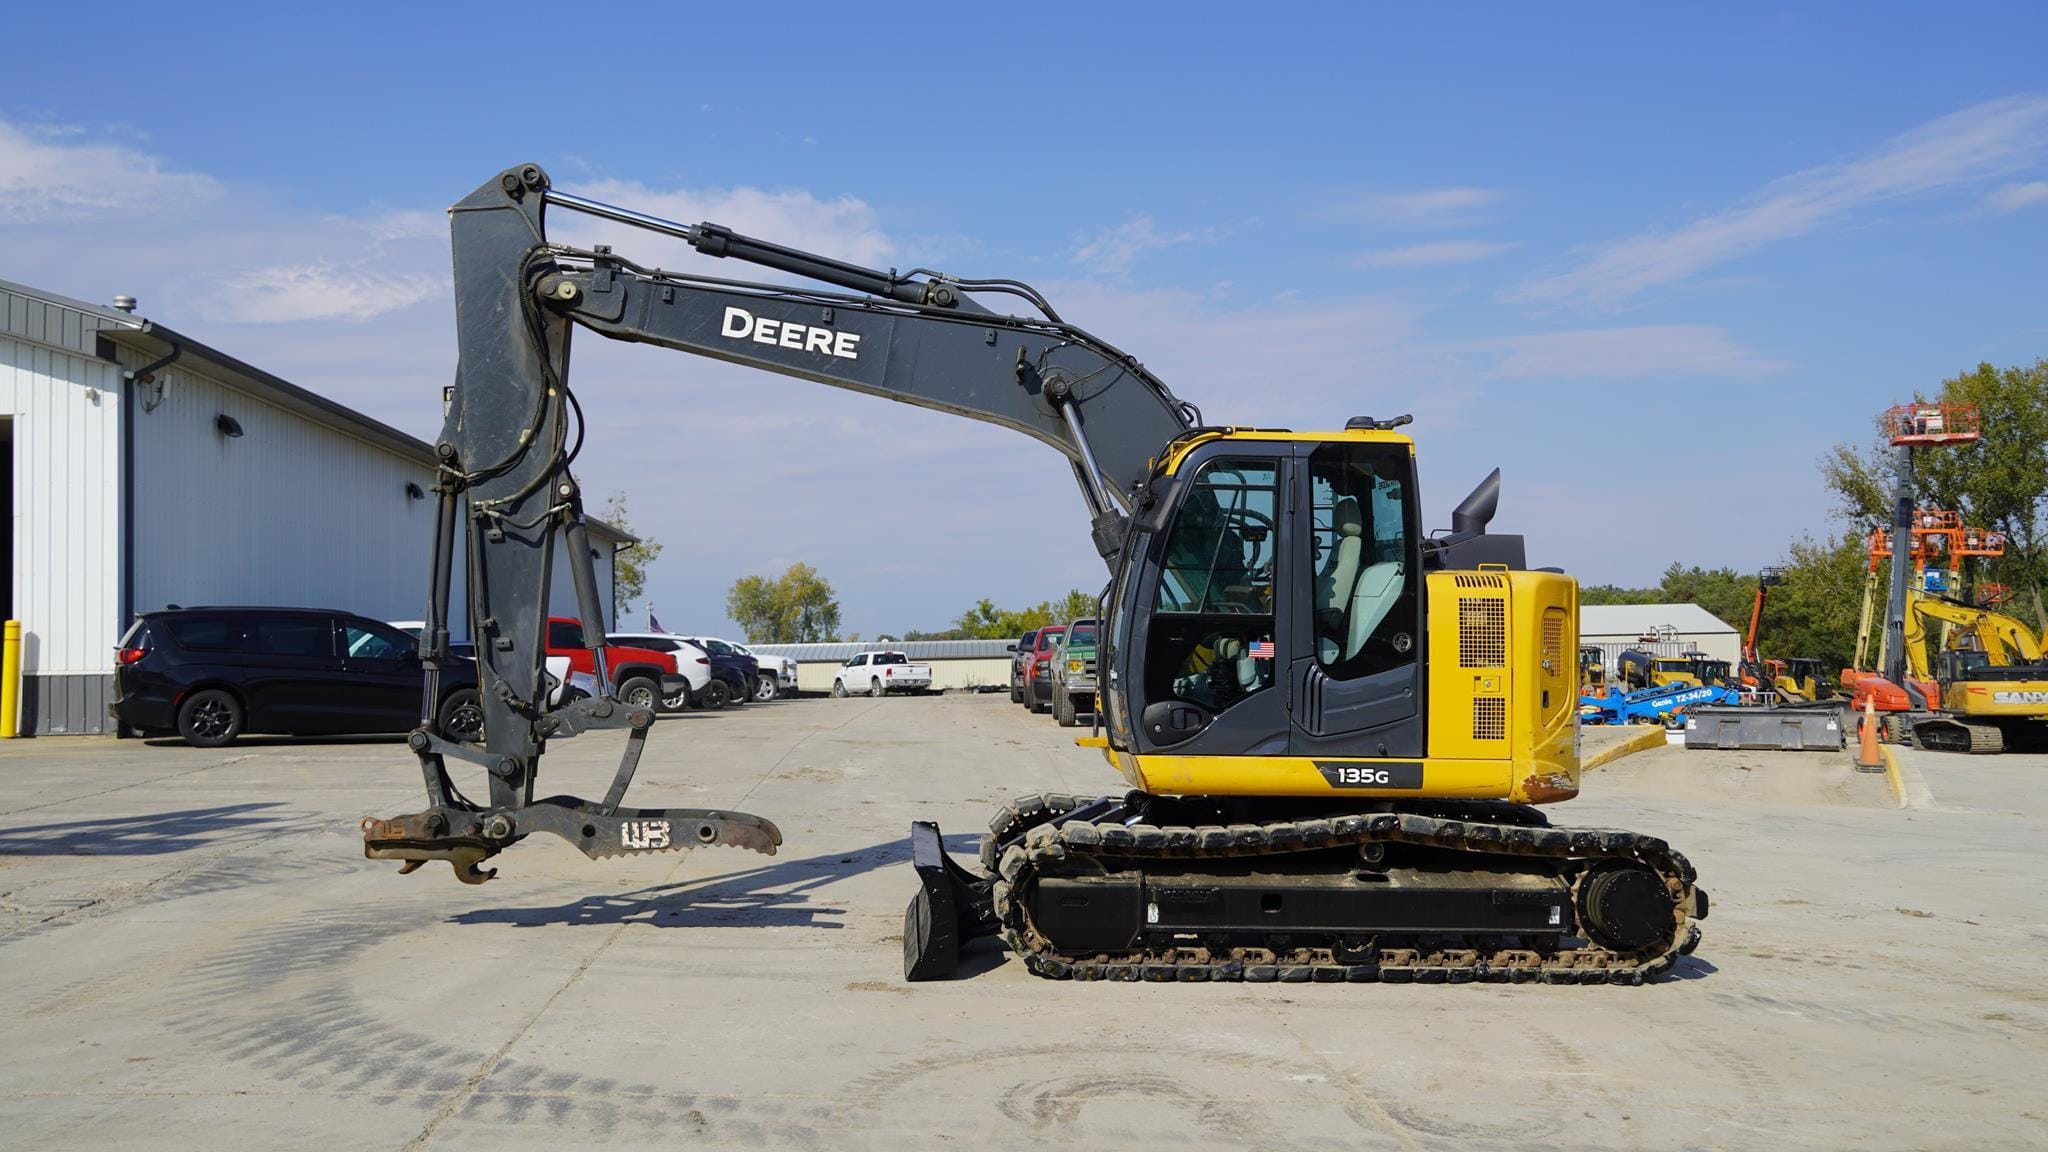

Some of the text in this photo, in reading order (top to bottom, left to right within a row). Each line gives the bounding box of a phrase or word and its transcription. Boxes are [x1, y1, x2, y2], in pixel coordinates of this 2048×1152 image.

[721, 306, 861, 359] DEERE
[1652, 690, 1712, 707] Genie TZ-34/20
[1338, 768, 1389, 784] 135G
